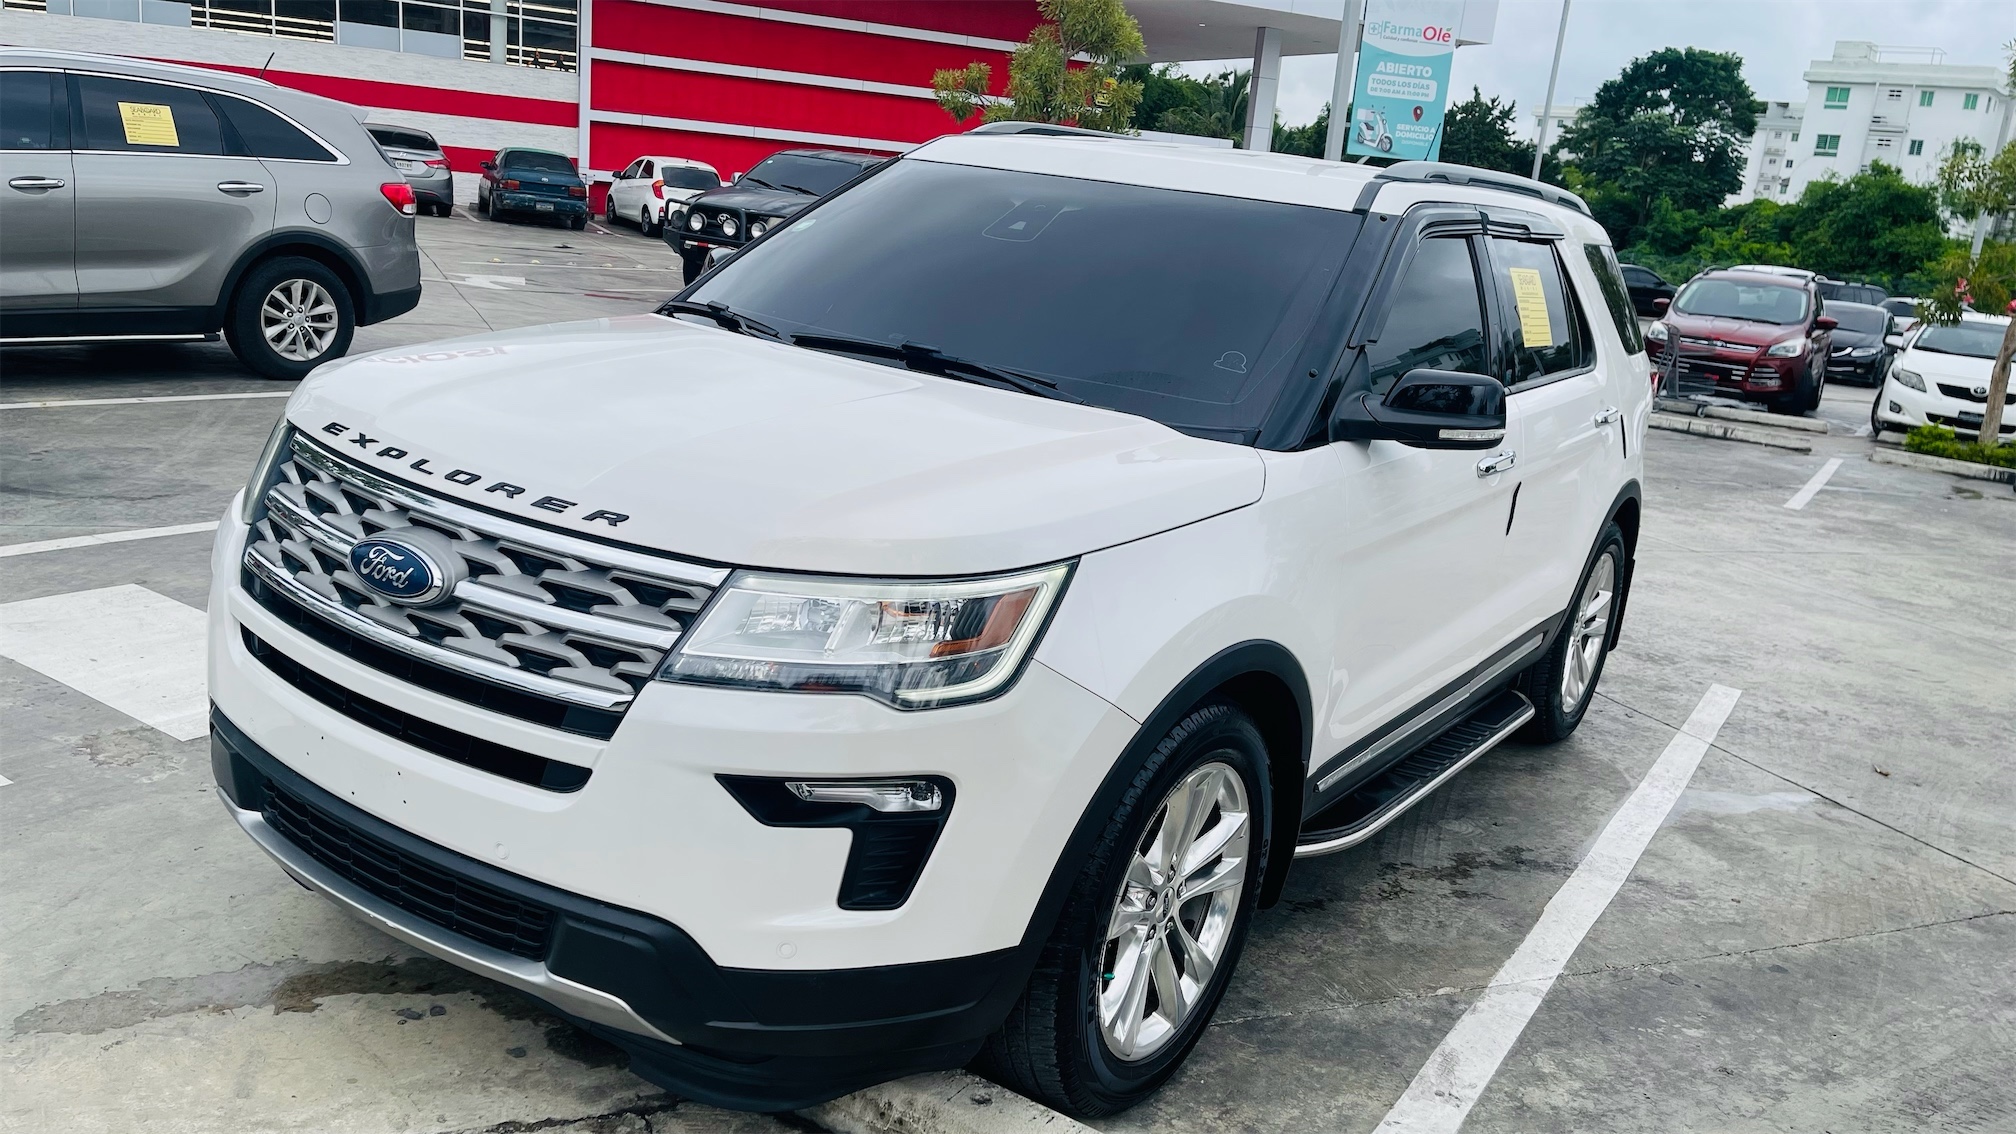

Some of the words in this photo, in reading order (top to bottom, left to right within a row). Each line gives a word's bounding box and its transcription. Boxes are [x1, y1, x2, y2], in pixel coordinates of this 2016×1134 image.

[1376, 61, 1432, 78] ABIERTO
[1371, 78, 1397, 87] TODOS
[1397, 81, 1411, 89] LOS
[1412, 81, 1430, 91] DÍAS
[1396, 123, 1429, 132] SERVICIO
[1395, 131, 1434, 140] DOMICILIO
[322, 421, 630, 527] EXPLORER
[360, 546, 414, 589] Ford
